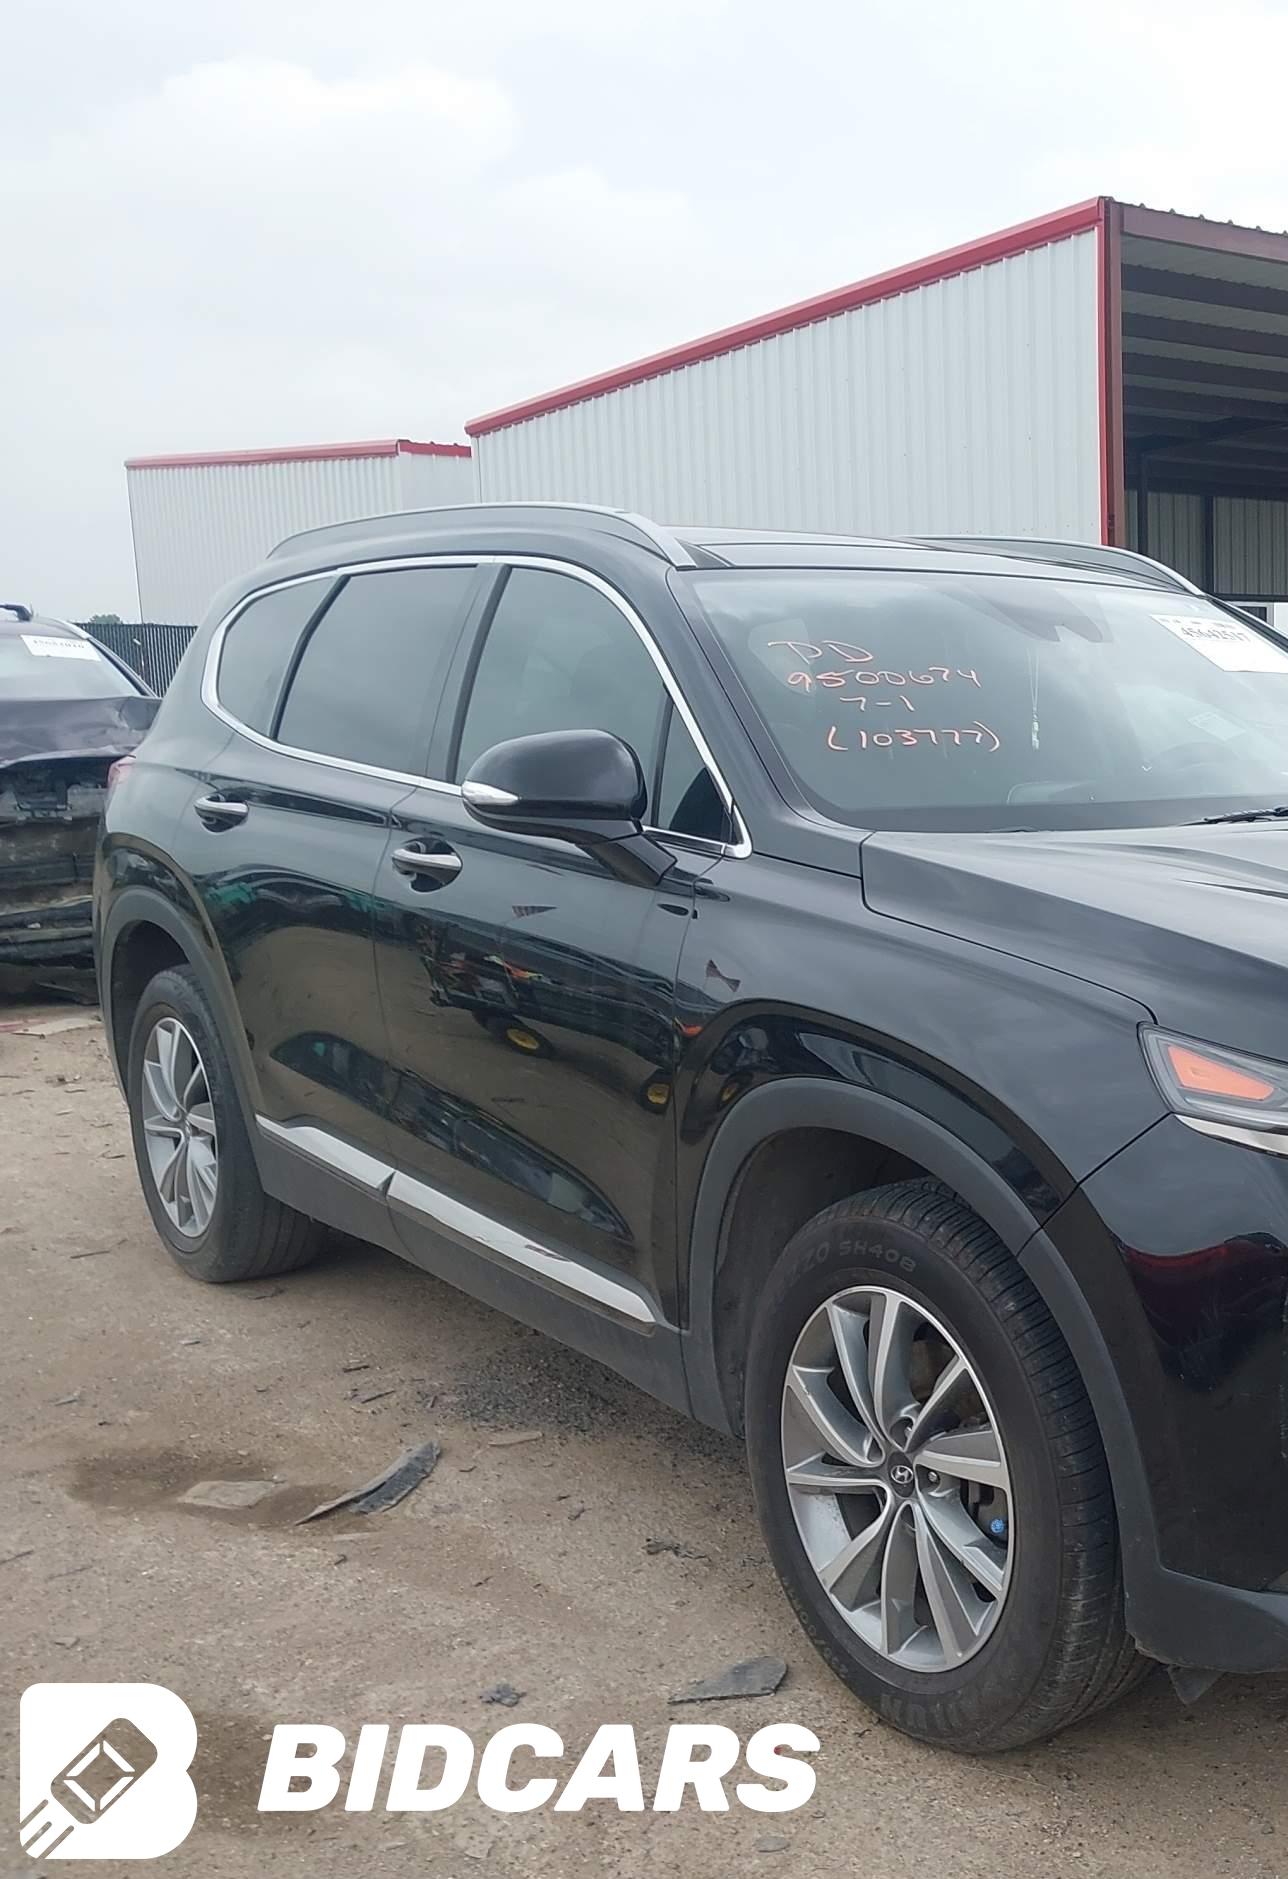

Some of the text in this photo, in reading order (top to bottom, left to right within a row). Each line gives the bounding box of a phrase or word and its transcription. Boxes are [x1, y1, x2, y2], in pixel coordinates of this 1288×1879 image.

[787, 665, 983, 693] 9500674
[839, 695, 915, 712] 7-1
[827, 720, 1001, 752] (103777)
